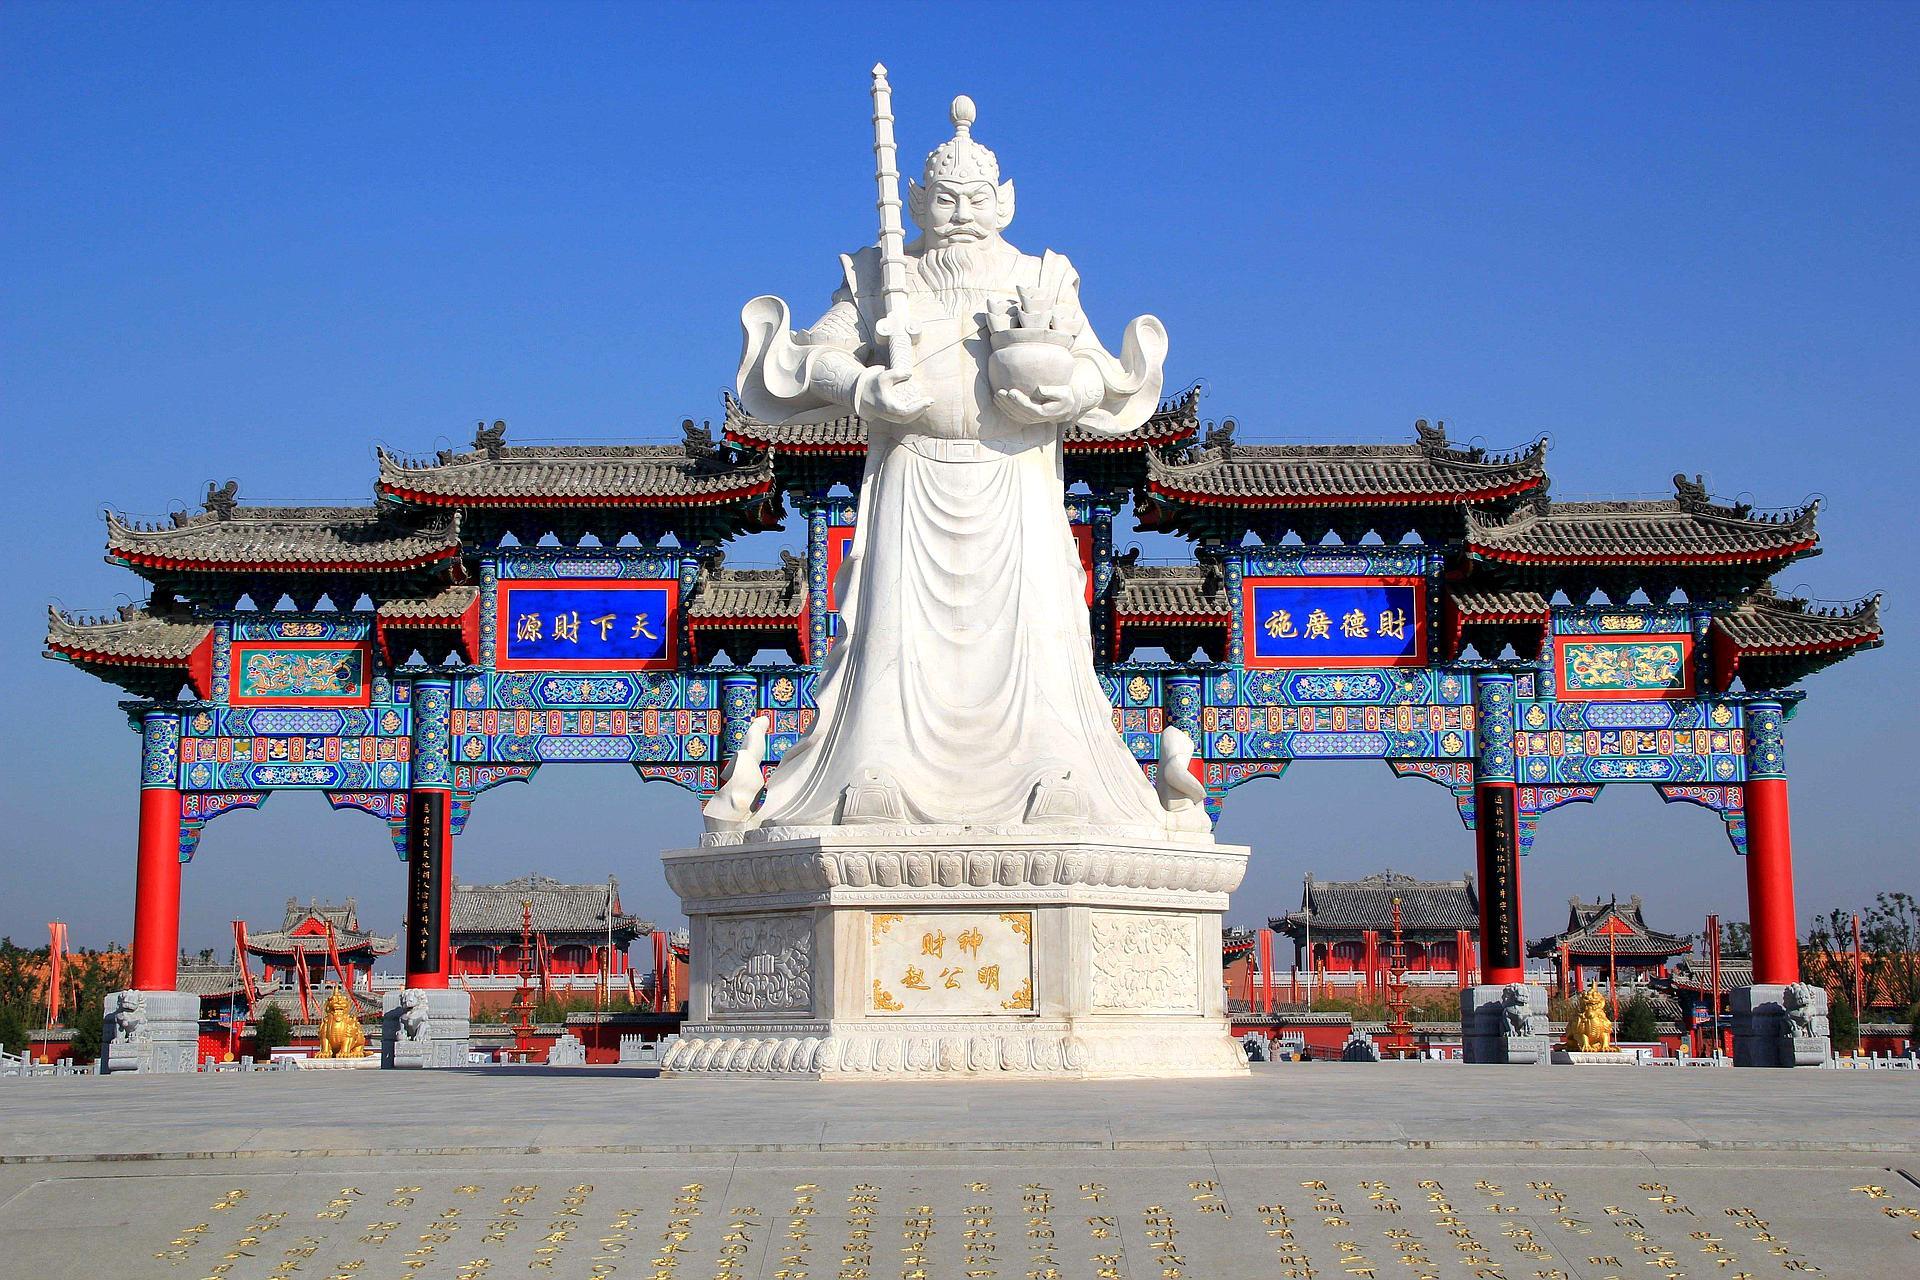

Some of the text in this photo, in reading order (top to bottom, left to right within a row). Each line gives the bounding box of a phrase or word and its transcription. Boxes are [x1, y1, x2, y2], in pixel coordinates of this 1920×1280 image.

[921, 926, 984, 960] 财神
[900, 963, 1000, 992] 赵公明
